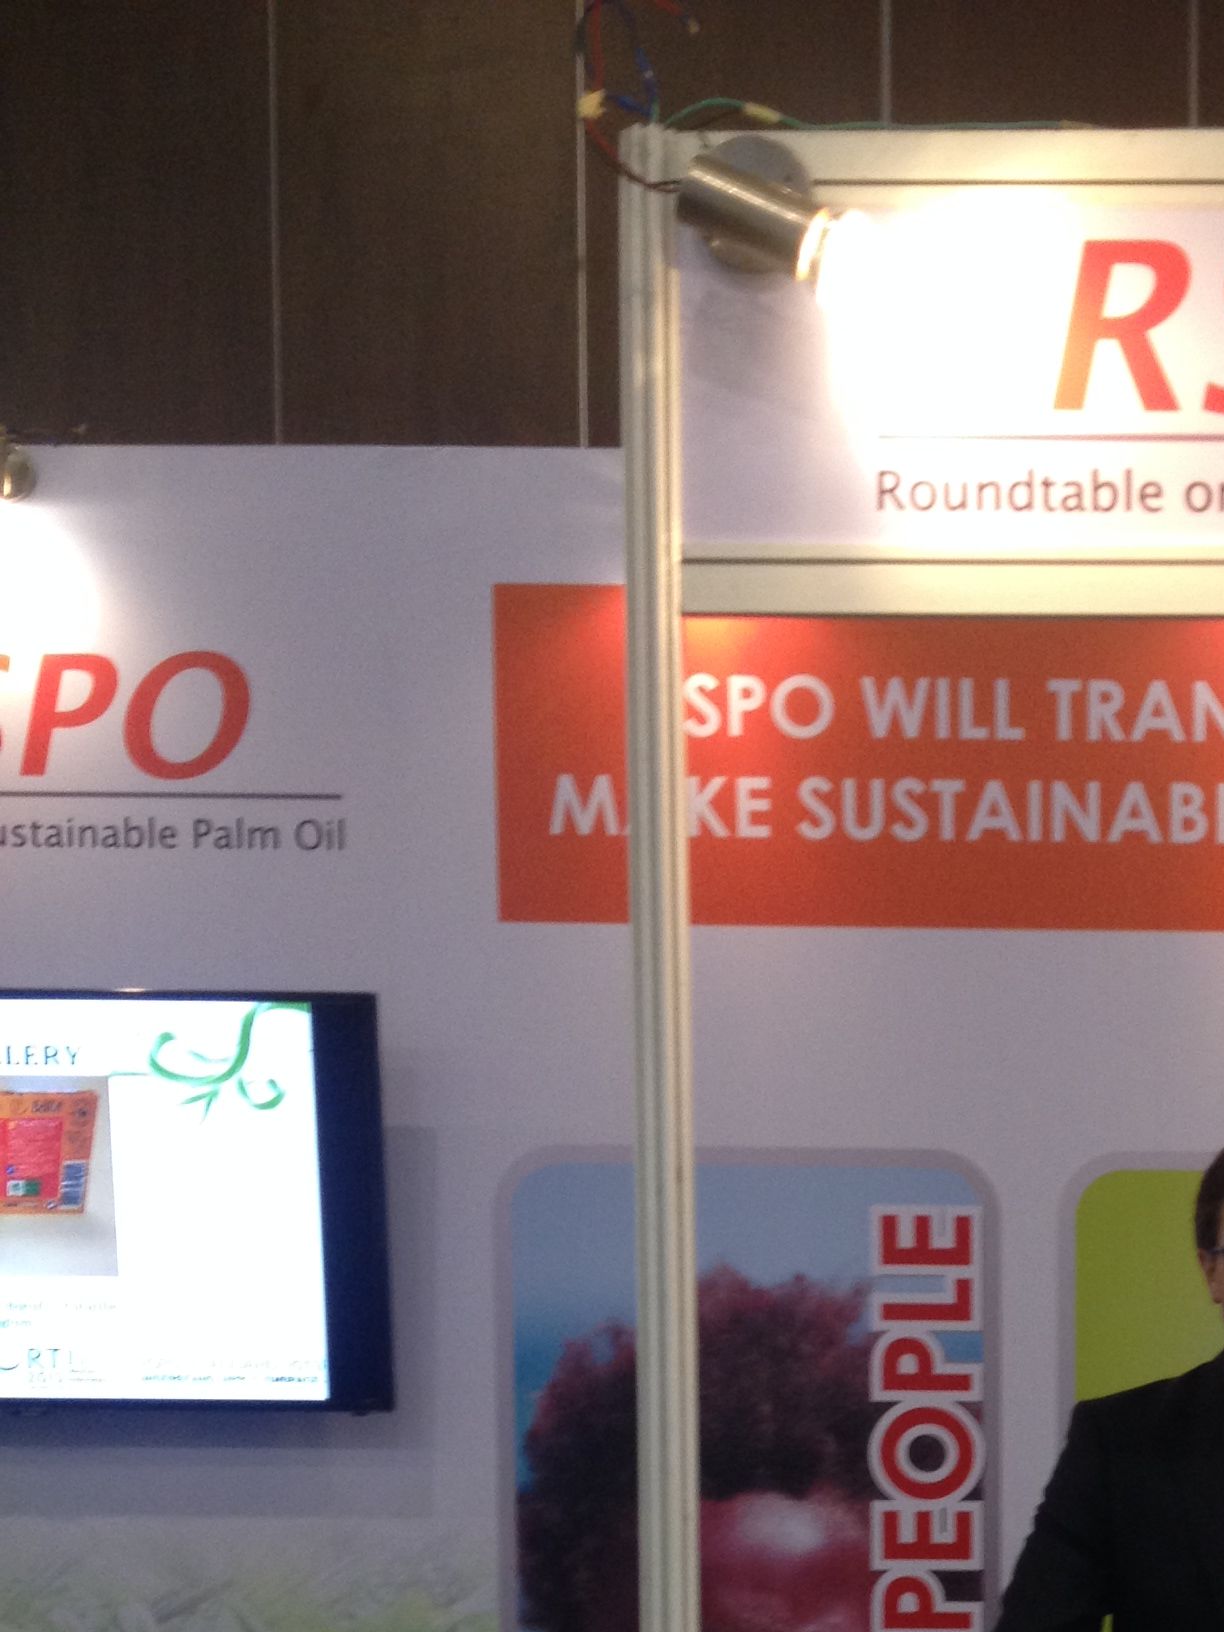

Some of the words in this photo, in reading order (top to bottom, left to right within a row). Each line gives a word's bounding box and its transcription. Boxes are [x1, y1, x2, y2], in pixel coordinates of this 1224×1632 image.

[875, 468, 1166, 513] Roundtable
[0, 651, 251, 781] PO
[684, 673, 837, 741] SPO
[860, 676, 1026, 742] WILL
[193, 818, 282, 851] Palm
[294, 819, 346, 852] Oil
[549, 773, 775, 839] MKE
